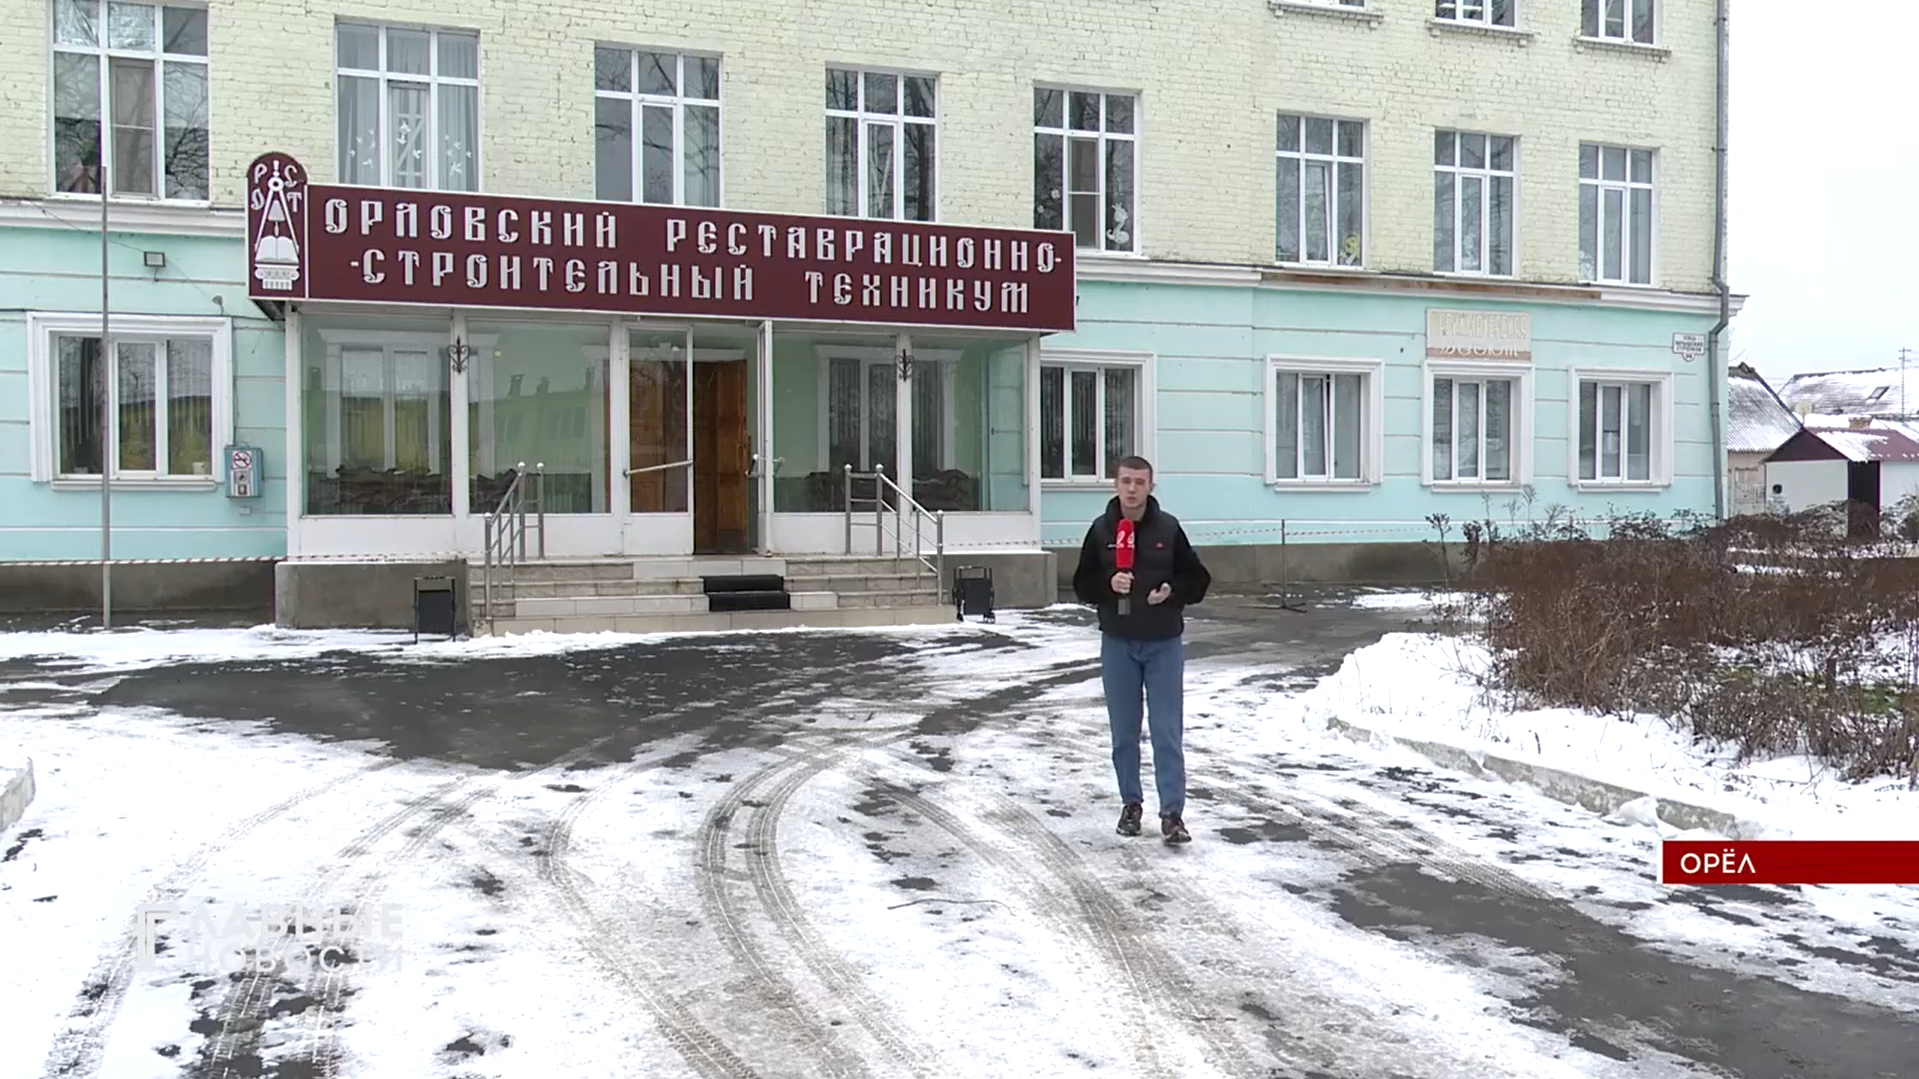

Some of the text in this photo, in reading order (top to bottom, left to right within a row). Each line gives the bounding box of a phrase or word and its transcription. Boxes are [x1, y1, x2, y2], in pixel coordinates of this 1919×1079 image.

[324, 198, 1062, 274] ОРЛОВСКИЙ РЕСТАВРАЦИОННО-
[350, 248, 1029, 314] -СТРОИТЕЛЬНЫЙ ТЕХНИКУМ
